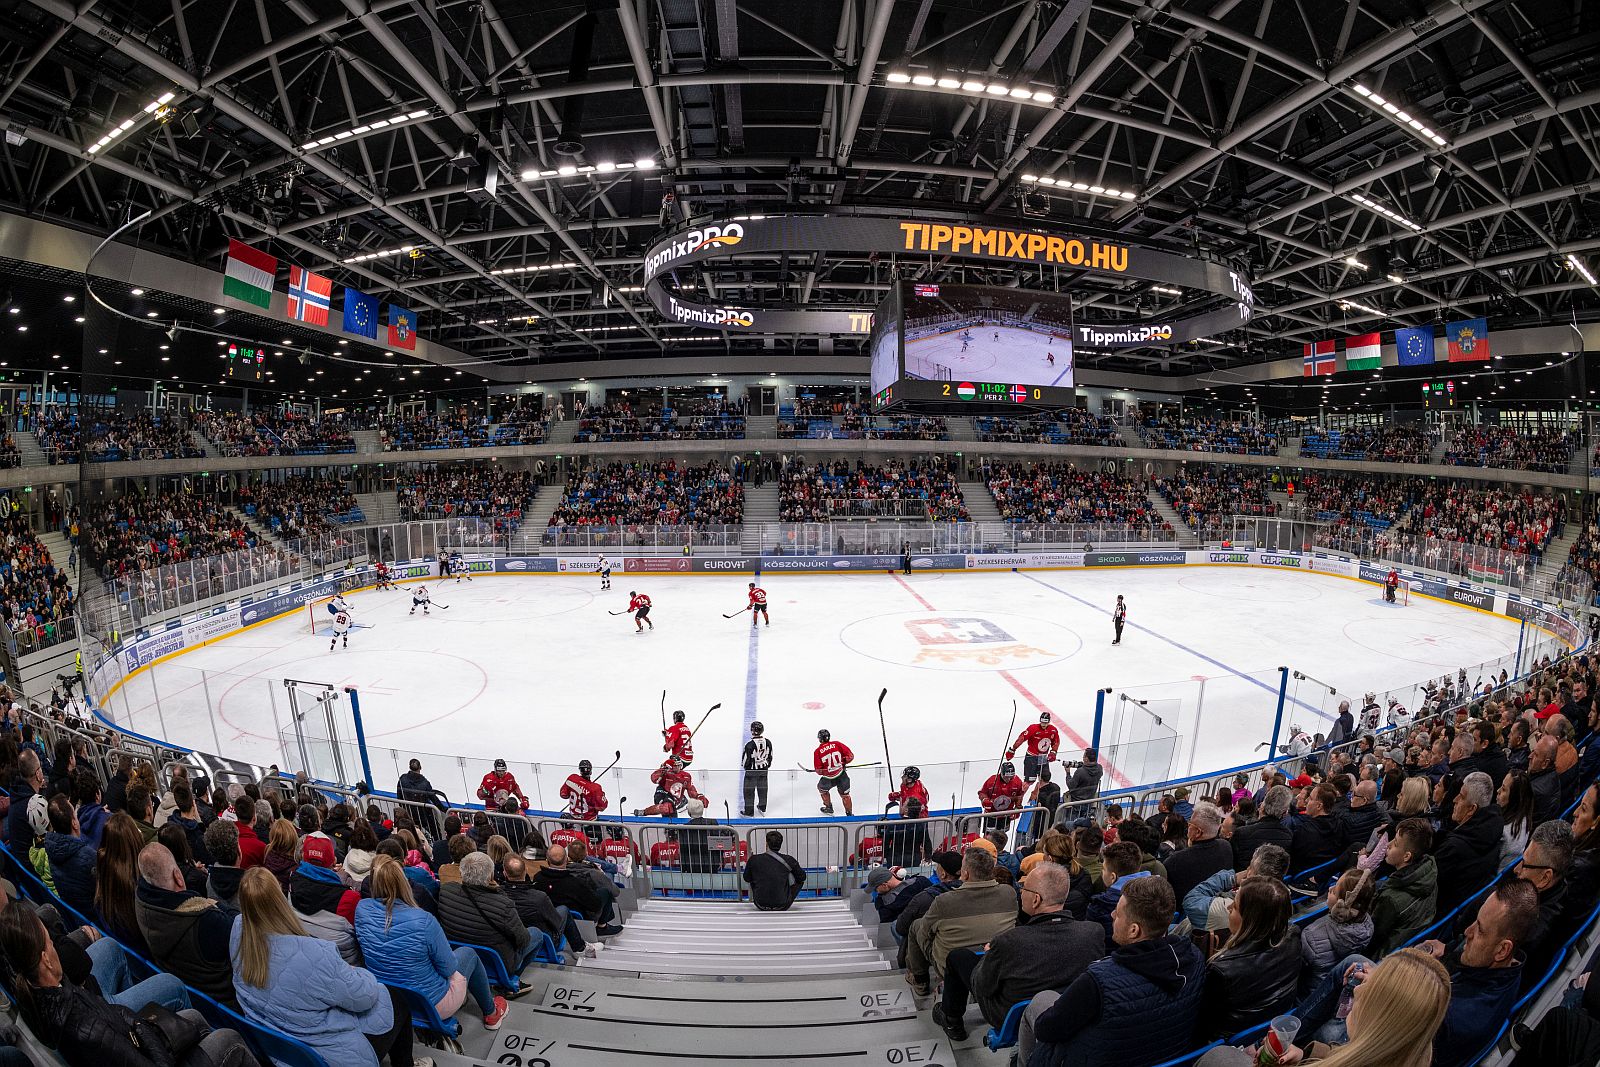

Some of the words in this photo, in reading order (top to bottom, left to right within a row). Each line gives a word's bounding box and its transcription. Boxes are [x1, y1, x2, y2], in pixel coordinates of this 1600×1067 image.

[644, 223, 744, 279] TippmixPRO
[900, 222, 1128, 272] TIPPMIXPRO.HU
[669, 297, 754, 327] TippmixPRO
[1079, 325, 1173, 346] TippmixPRO
[942, 384, 951, 396] 2
[980, 384, 1006, 394] 11:02
[1033, 388, 1041, 400] 0
[704, 560, 747, 569] EUROVIT
[764, 560, 828, 568] KÖSZÖNJÜK!
[977, 557, 1026, 565] SZÉKESFEHÉRVÁR
[293, 585, 334, 604] KÖSZÖNJÜK!
[1454, 591, 1483, 606] EUROVIT
[336, 615, 346, 625] 29
[821, 751, 842, 773] 70
